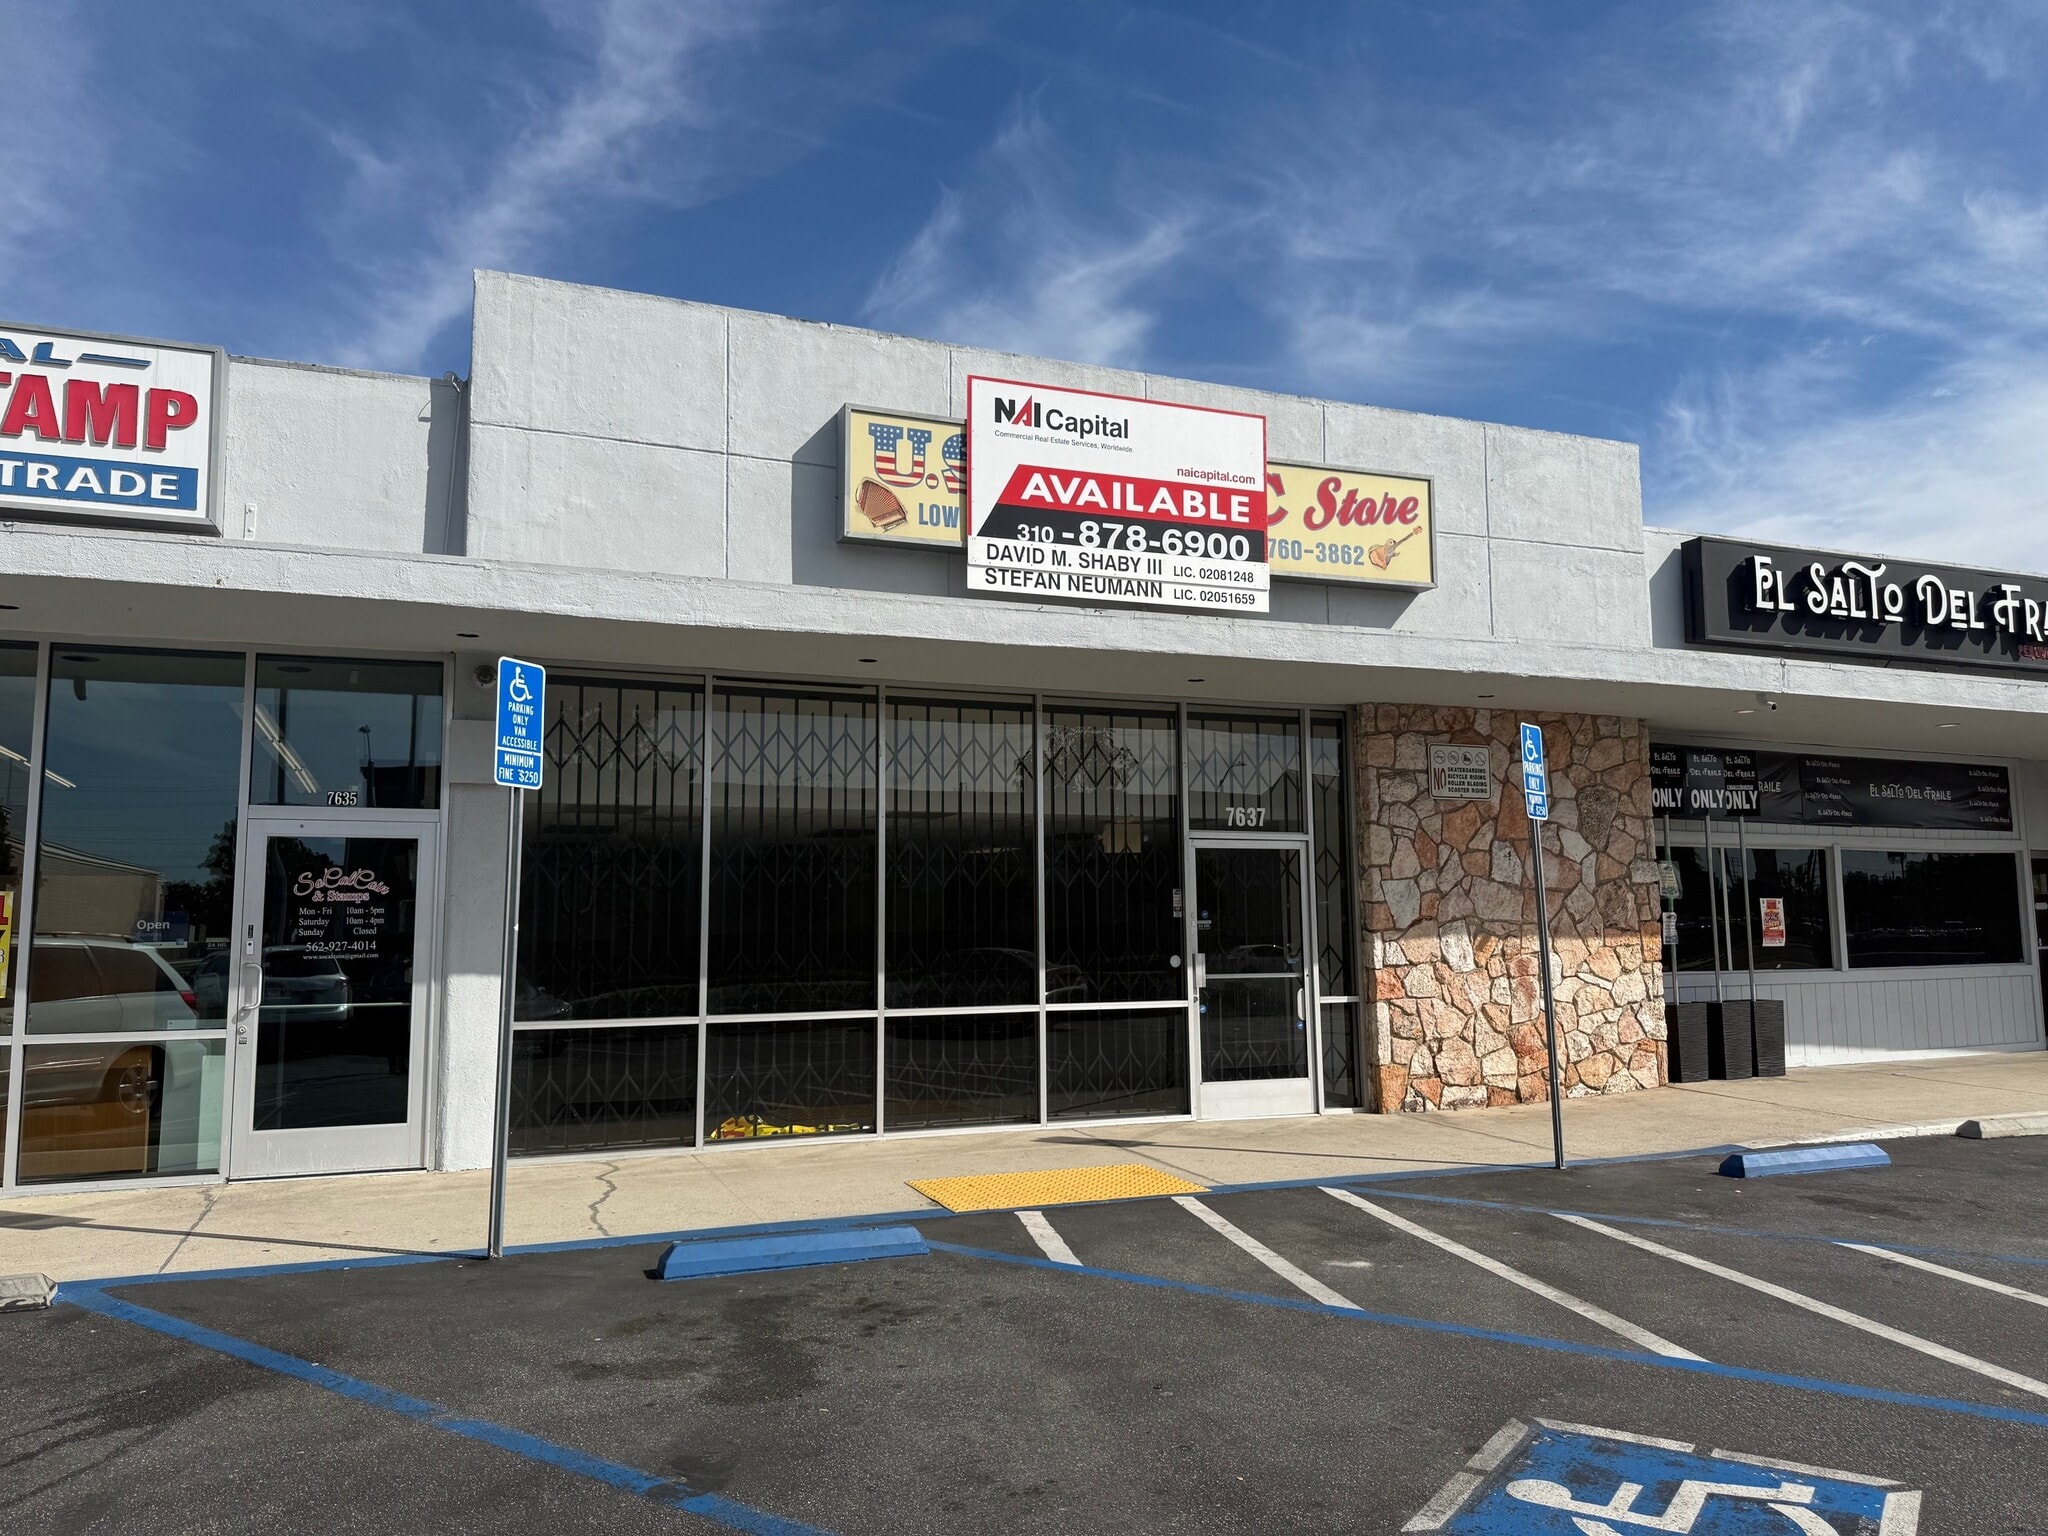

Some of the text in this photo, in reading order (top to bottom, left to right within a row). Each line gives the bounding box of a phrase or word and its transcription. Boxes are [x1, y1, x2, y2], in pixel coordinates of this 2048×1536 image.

[994, 395, 1129, 439] NAI Capital
[994, 430, 1033, 441] Commercial
[1035, 434, 1049, 443] Real
[1050, 436, 1070, 446] Estate
[1071, 439, 1100, 450] Services,
[0, 459, 179, 500] TRADE
[1177, 466, 1256, 485] naicapital.com
[1021, 472, 1250, 523] AVAILABLE
[1303, 476, 1419, 531] Store
[918, 502, 960, 528] LOW
[986, 543, 1254, 583] DAVID M. SHABY III LIC. 02081248
[985, 567, 1256, 605] STEFAN NEUMANN LIC. 02051659
[508, 702, 534, 716] PARKING
[512, 714, 529, 726] ONLY
[514, 725, 527, 737] VAN
[501, 736, 538, 751] ACCESSIBLE
[504, 753, 534, 769] MINIMUM
[498, 767, 539, 784] FINE $250
[1433, 767, 1447, 791] NO
[1758, 781, 1781, 793] RAILE
[327, 791, 357, 806] 7635
[1652, 787, 1683, 808] ONLY
[1690, 788, 1724, 809] ONLY
[1725, 790, 1758, 810] ONLY
[1225, 807, 1266, 827] 7637
[312, 890, 370, 904] & Stamps
[299, 907, 316, 915] Mon
[322, 907, 333, 915] Fri
[346, 906, 364, 914] 10am
[370, 906, 385, 916] 5pm
[137, 919, 170, 932] Open
[298, 918, 330, 927] Saturday
[346, 917, 364, 925] 10am
[369, 917, 385, 926] 4pm
[298, 927, 377, 938] Sunday Closed
[305, 940, 377, 952] 562-927-4014
